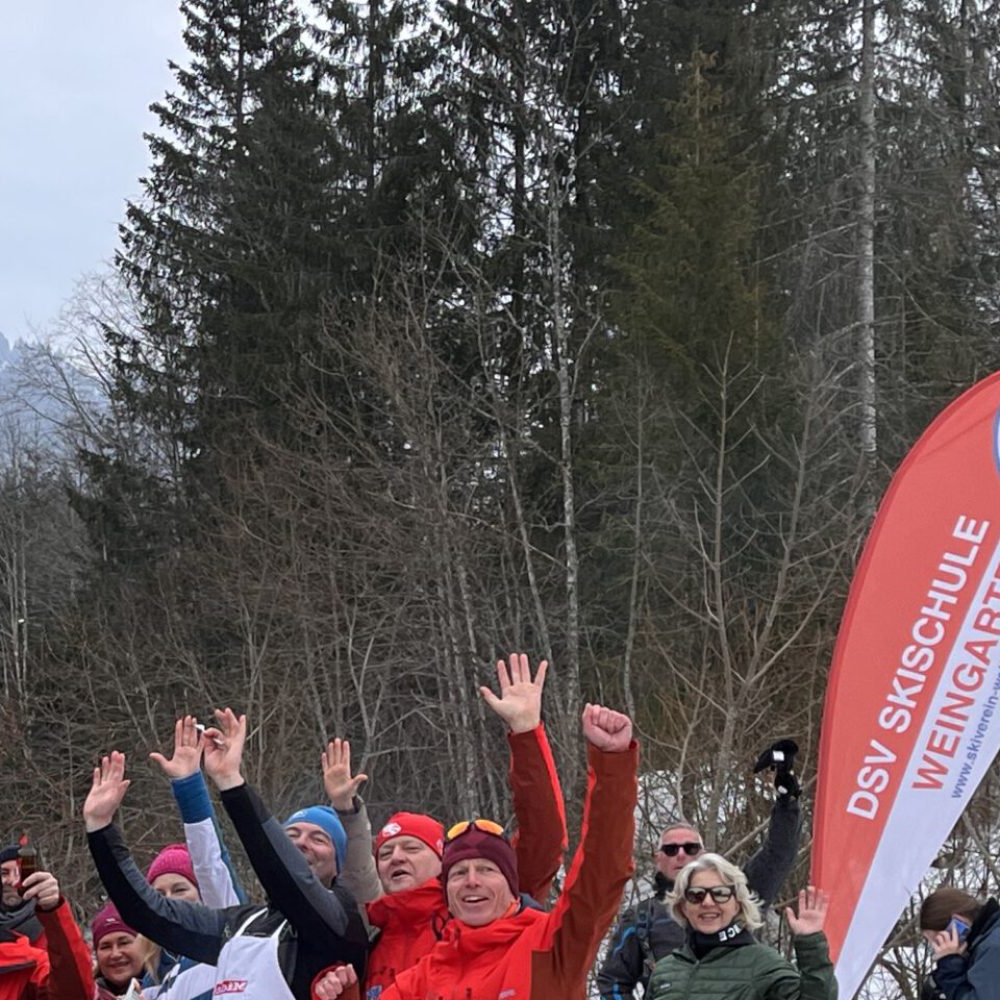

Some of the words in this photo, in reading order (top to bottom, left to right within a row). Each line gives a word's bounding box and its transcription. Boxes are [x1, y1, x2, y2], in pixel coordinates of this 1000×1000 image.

[846, 739, 897, 820] DSV
[878, 515, 990, 733] SKISCHULE
[912, 563, 1000, 790] WEINGART
